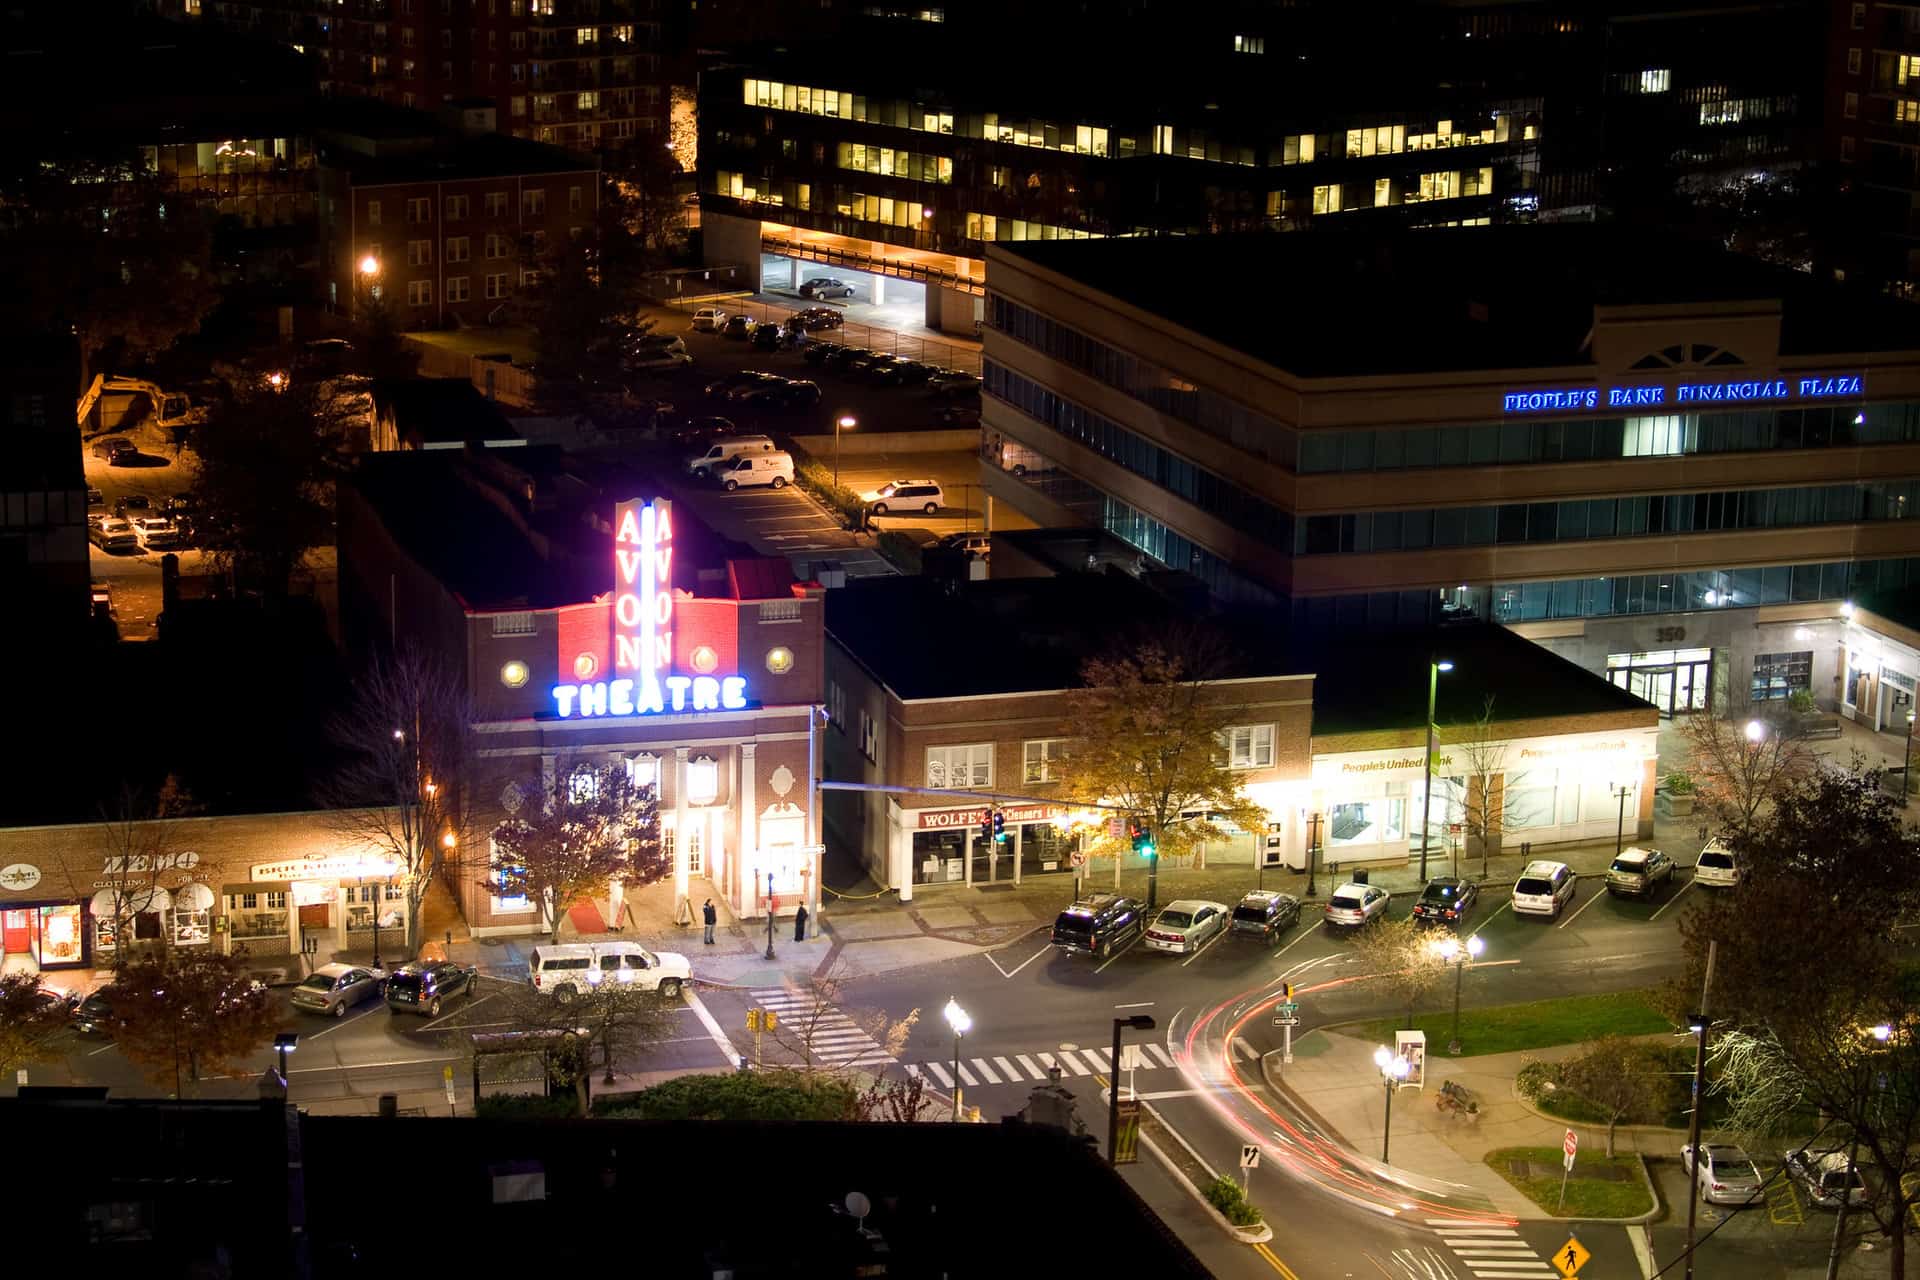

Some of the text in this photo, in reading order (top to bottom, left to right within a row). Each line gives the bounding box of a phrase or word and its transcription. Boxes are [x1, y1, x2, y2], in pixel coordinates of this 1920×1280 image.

[1504, 377, 1864, 411] PEOPLE'S BANK FINANCIAL PLAZA
[616, 509, 641, 667] AVON
[552, 676, 747, 717] THEATRE
[1386, 758, 1423, 771] United
